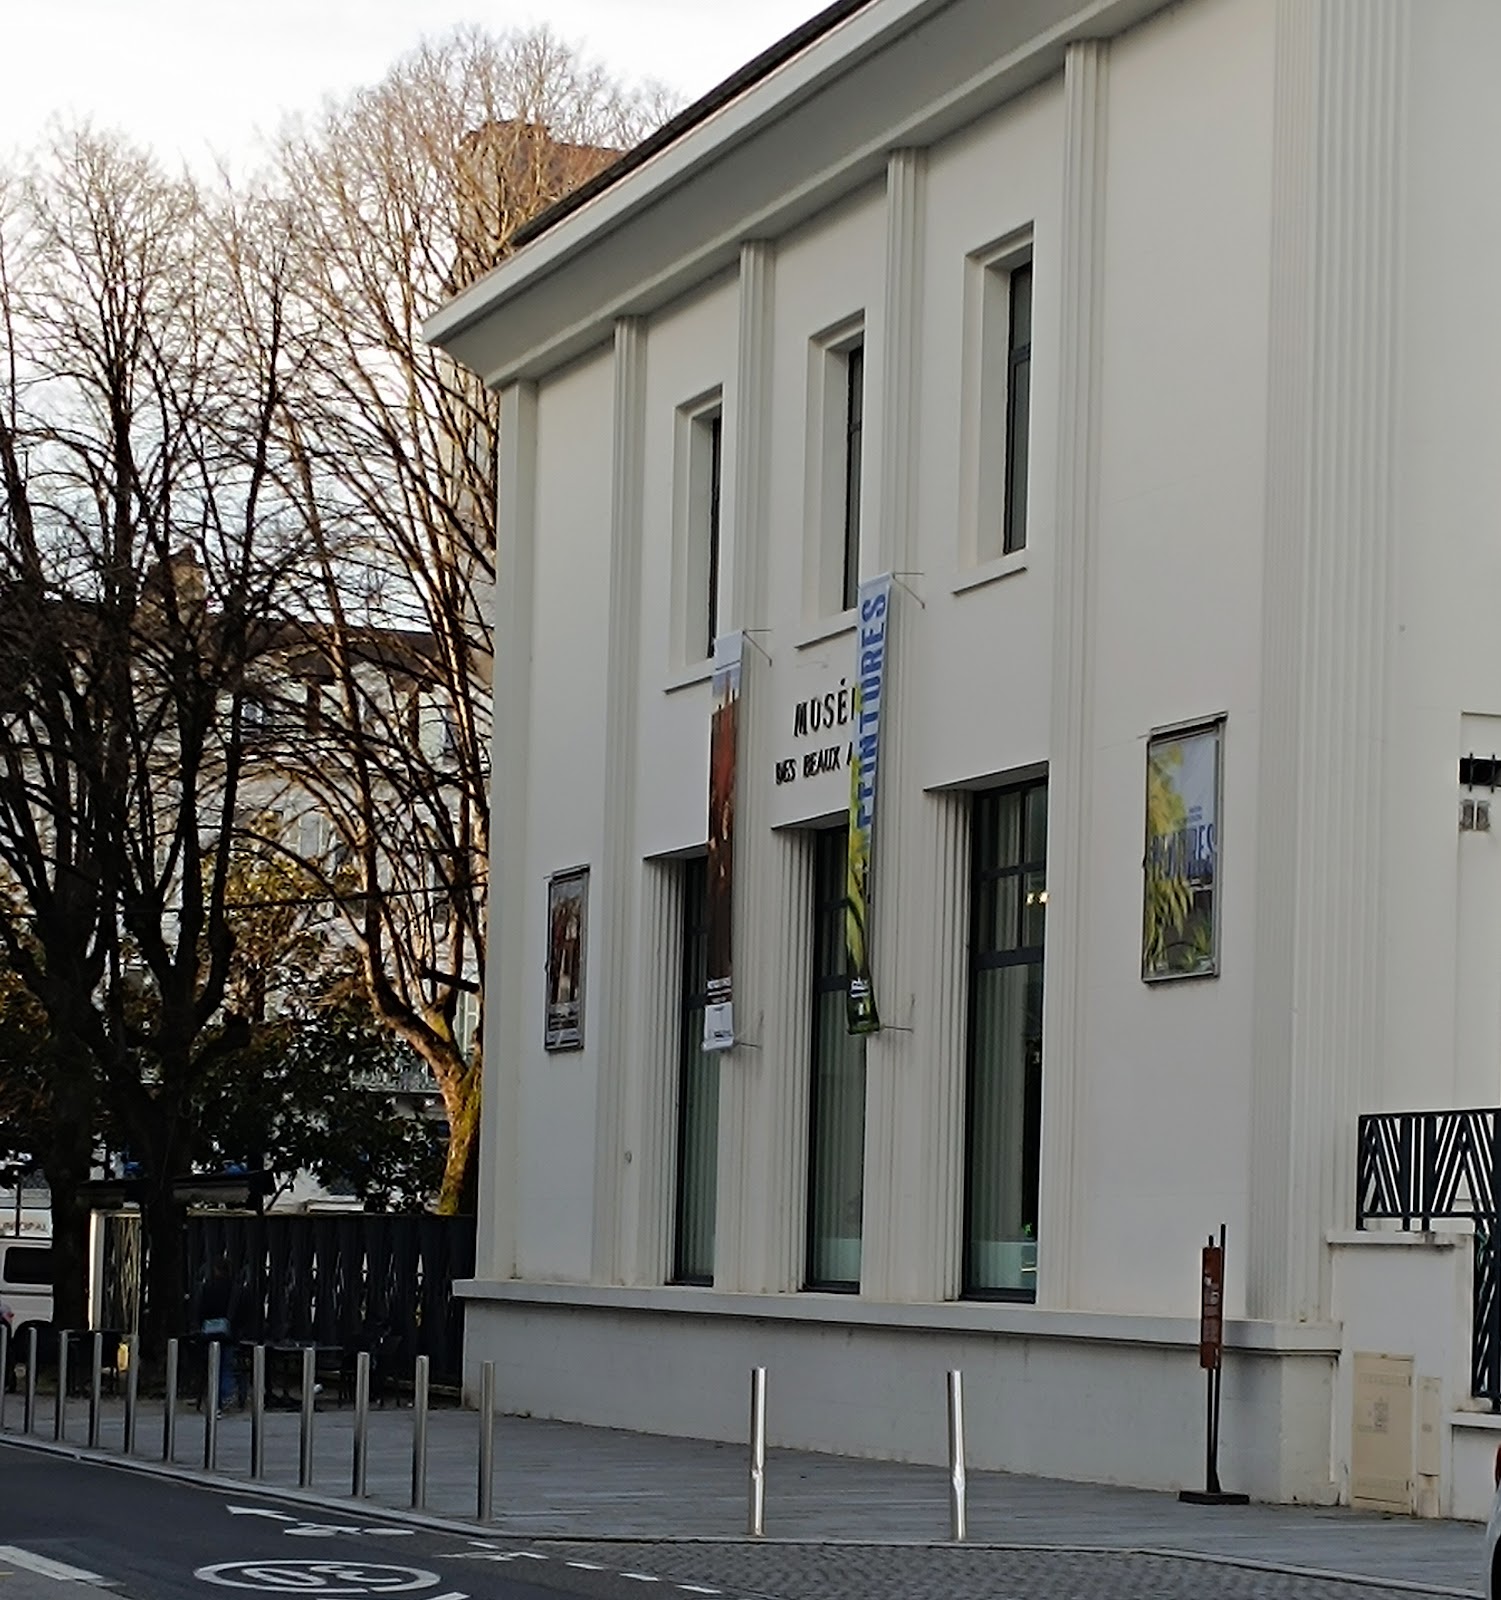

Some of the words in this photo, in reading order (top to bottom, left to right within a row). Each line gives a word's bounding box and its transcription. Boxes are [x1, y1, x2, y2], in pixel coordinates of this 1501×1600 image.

[793, 678, 856, 738] MUSÉ
[775, 758, 797, 786] DES
[803, 745, 841, 778] BEAUX
